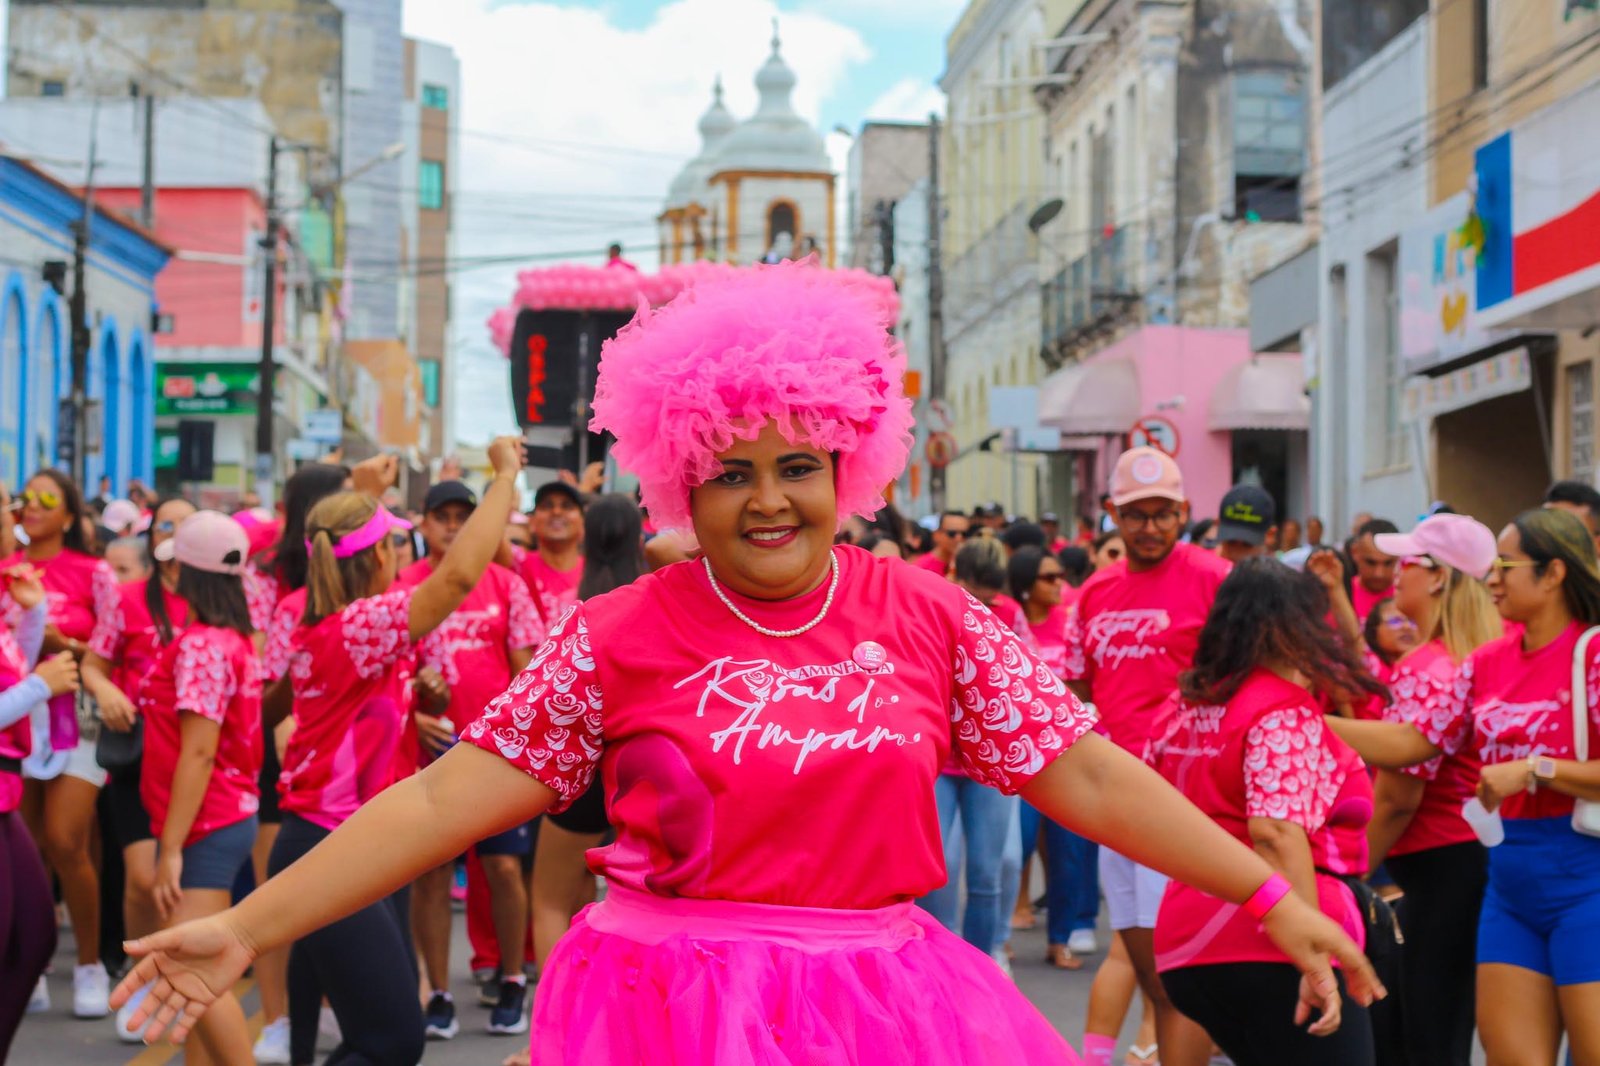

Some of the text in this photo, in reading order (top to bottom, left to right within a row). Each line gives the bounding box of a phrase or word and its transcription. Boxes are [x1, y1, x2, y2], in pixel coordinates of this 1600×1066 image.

[673, 655, 899, 723] Rosas do
[787, 660, 891, 681] CAMINHA
[709, 701, 921, 775] Amparo
